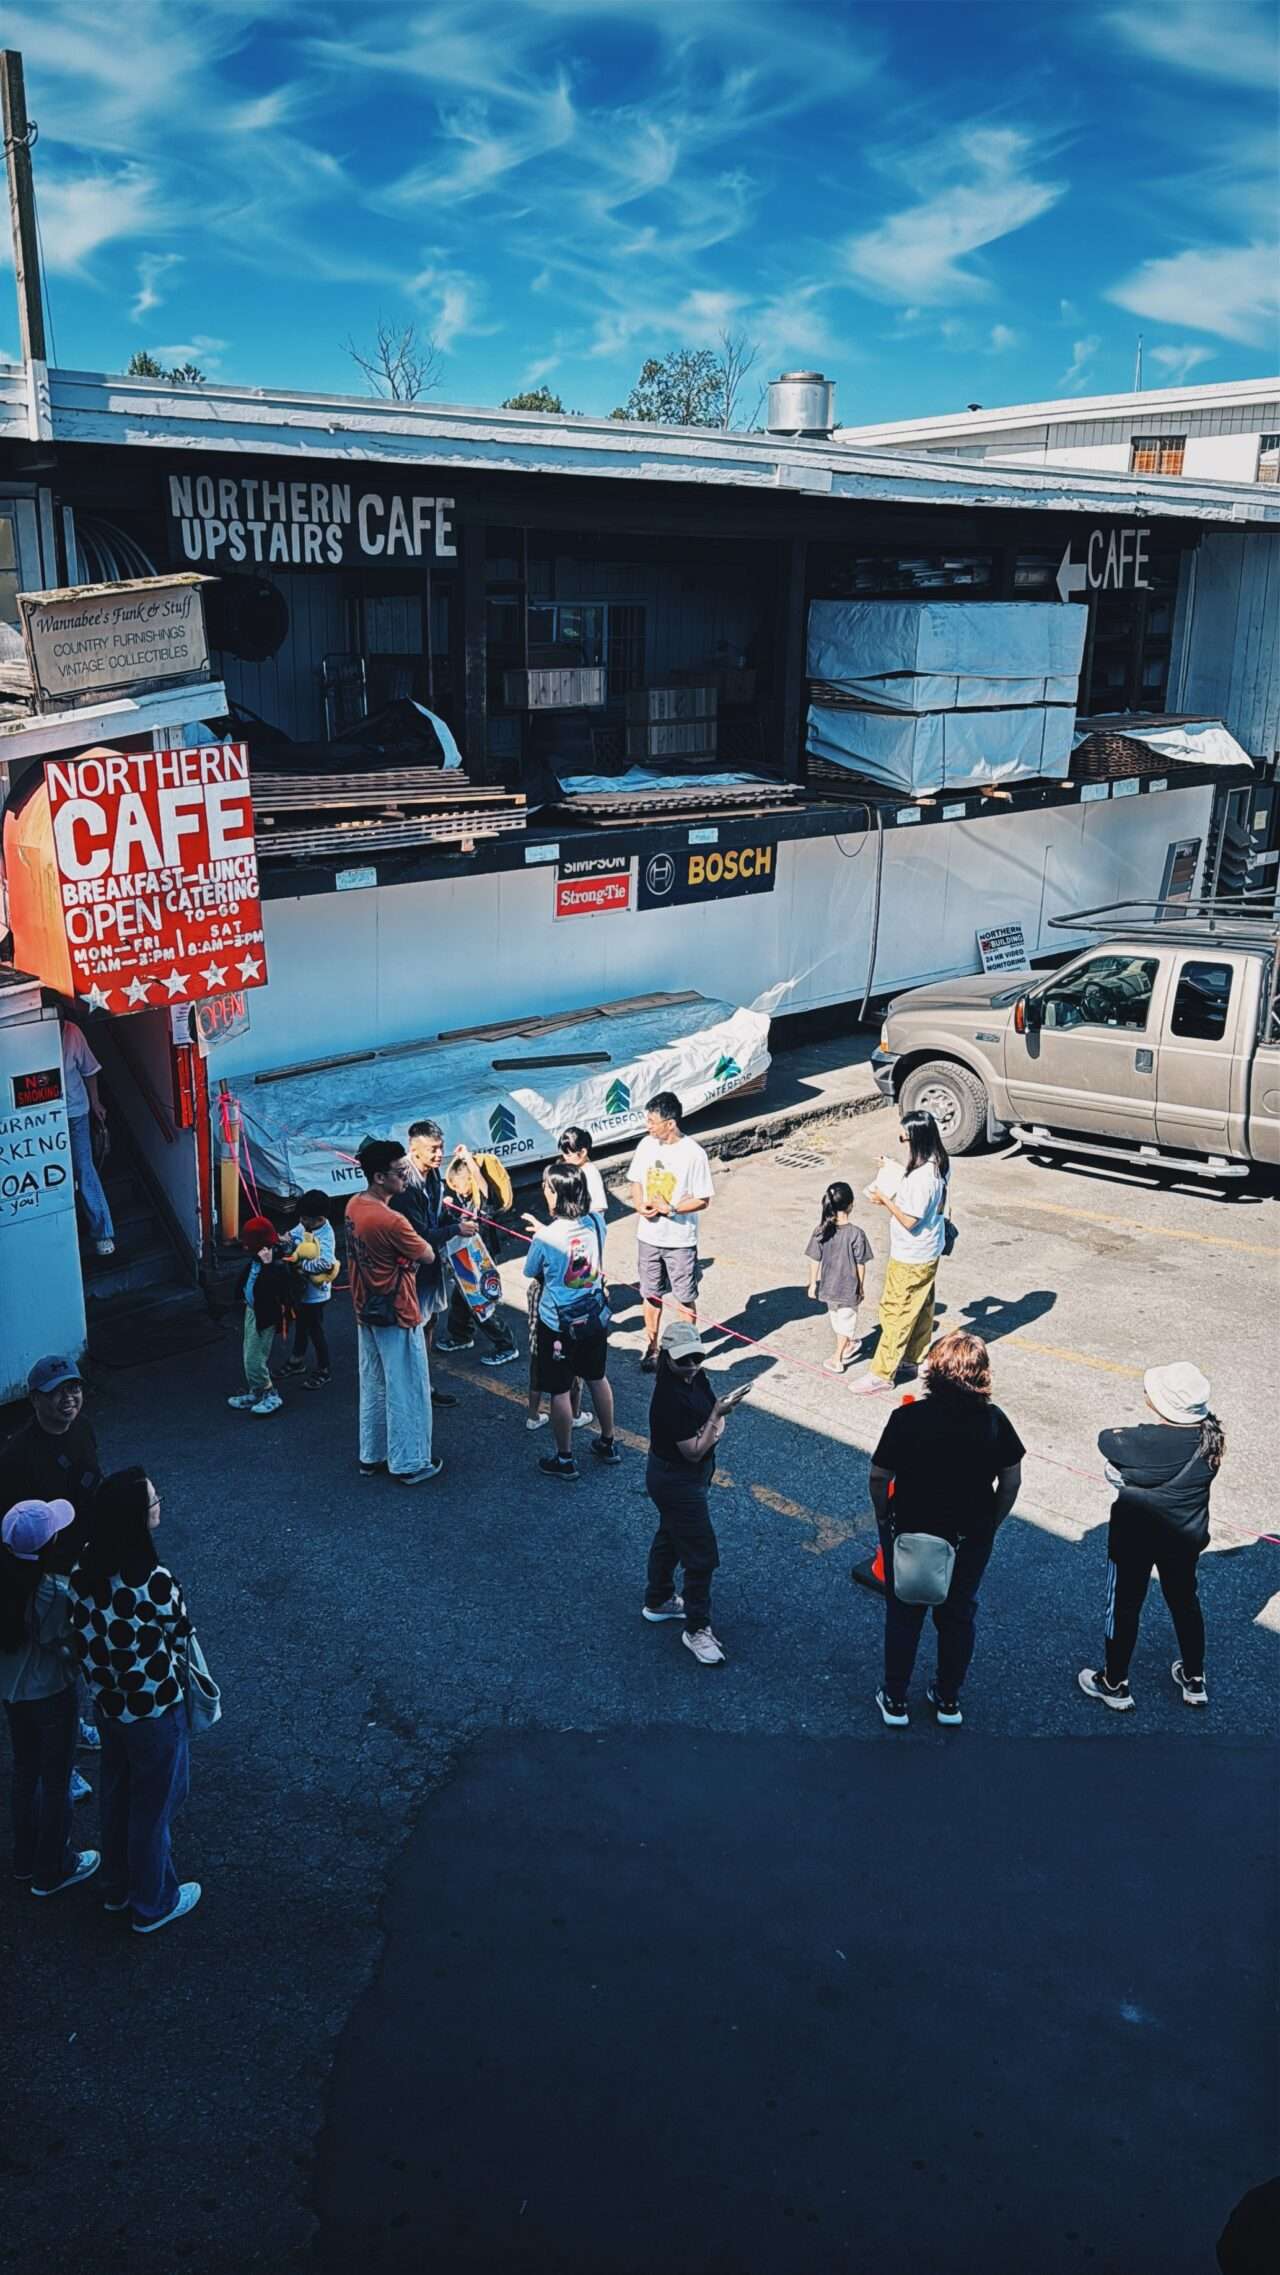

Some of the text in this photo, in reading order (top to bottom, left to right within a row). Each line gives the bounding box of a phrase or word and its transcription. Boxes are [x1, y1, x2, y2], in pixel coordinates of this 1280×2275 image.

[169, 475, 351, 524] NORTHERN
[181, 519, 343, 564] UPSTAIRS
[358, 494, 457, 556] CAFE
[1088, 529, 1151, 589] CAFE
[37, 595, 193, 633] Wannabee's Funk & Stuff
[53, 625, 186, 657] COUNTRY FURNISHINGS
[57, 644, 188, 678] VINTAGE COLLECTIBLES
[46, 743, 248, 801] NORTHERN
[53, 779, 255, 881] CAFE
[688, 846, 772, 885] BOSCH
[165, 879, 260, 912] CATERING
[560, 884, 626, 906] Strong-Tie
[65, 896, 163, 944] OPEN
[210, 920, 243, 938] SAT
[980, 926, 1021, 940] NORTHERN
[991, 934, 1024, 948] BUILDING
[1005, 948, 1024, 958] VIDEO
[987, 957, 1026, 971] MONITORING
[200, 991, 244, 1036] OPEN
